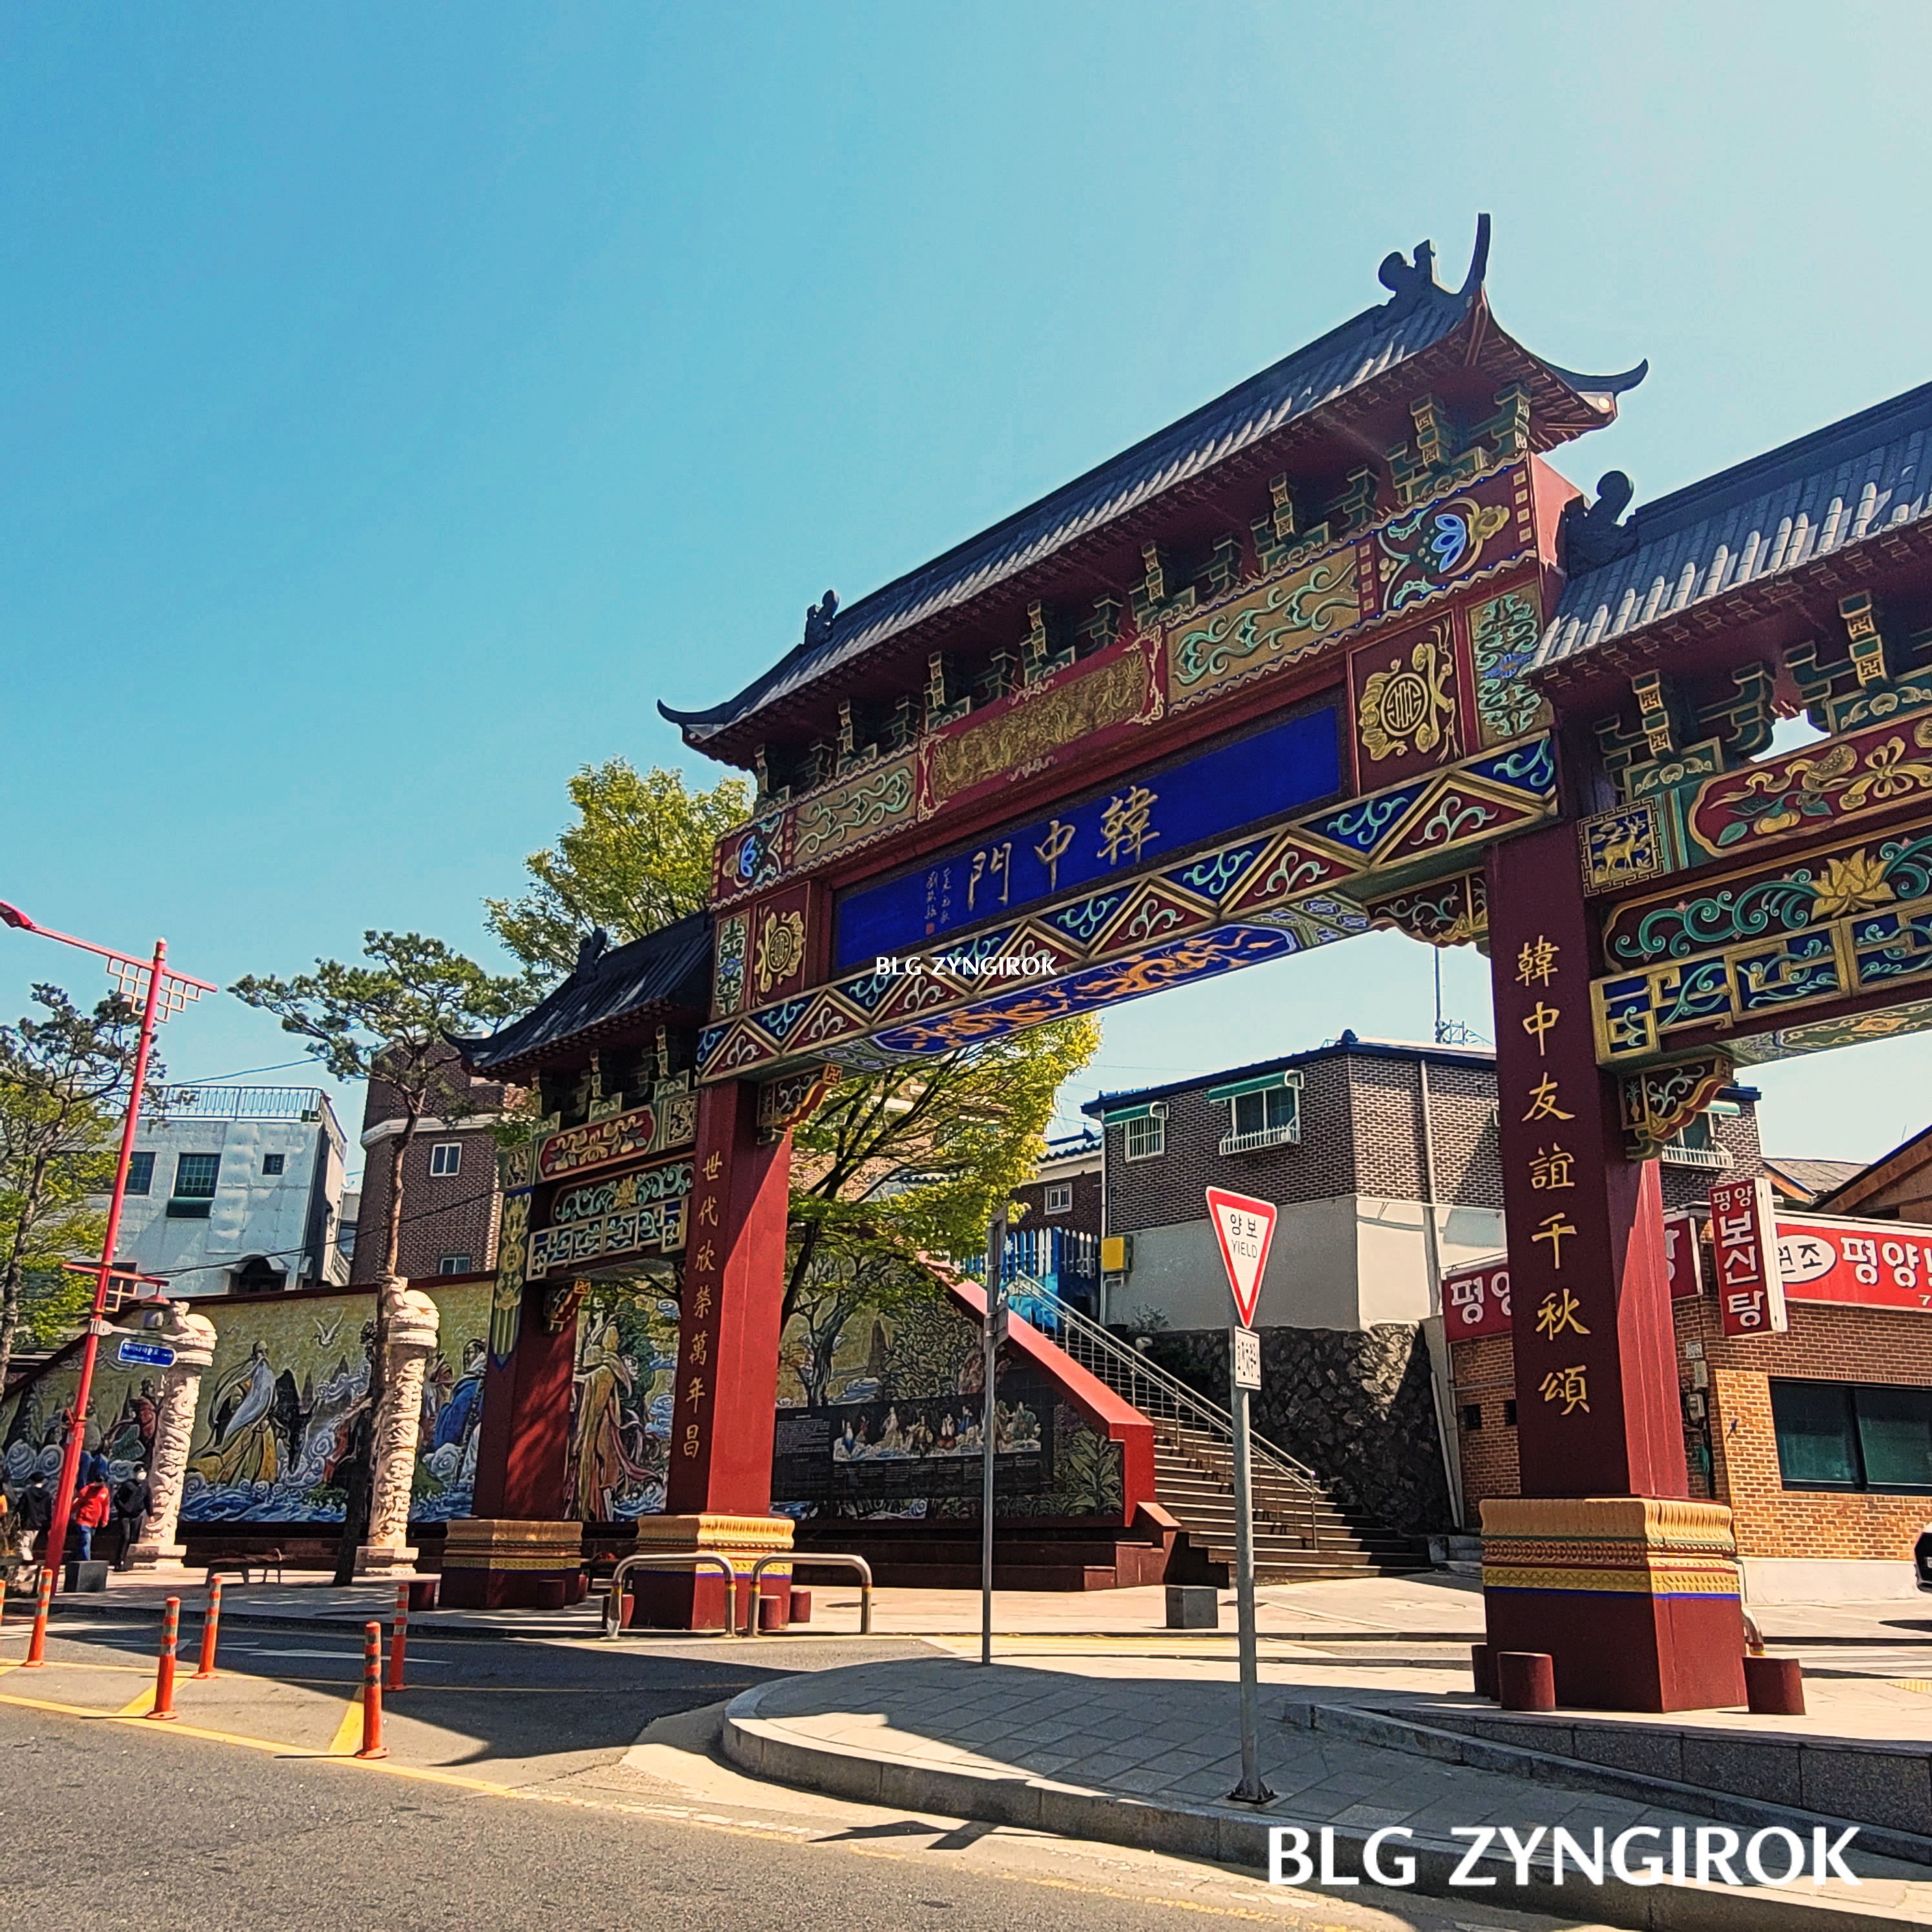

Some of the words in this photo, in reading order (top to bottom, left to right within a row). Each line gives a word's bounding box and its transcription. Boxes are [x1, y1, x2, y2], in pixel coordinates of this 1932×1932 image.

[969, 786, 1160, 911] 韓中門
[1515, 934, 1592, 1415] 韓中友誼千秋頌
[1712, 1186, 1752, 1211] 평양
[1230, 1214, 1257, 1238] 양보
[1231, 1239, 1258, 1258] YIELD
[1841, 1237, 1932, 1288] 평양
[683, 1151, 722, 1458] 世代欣榮萬年昌
[1719, 1211, 1764, 1327] 보신탕
